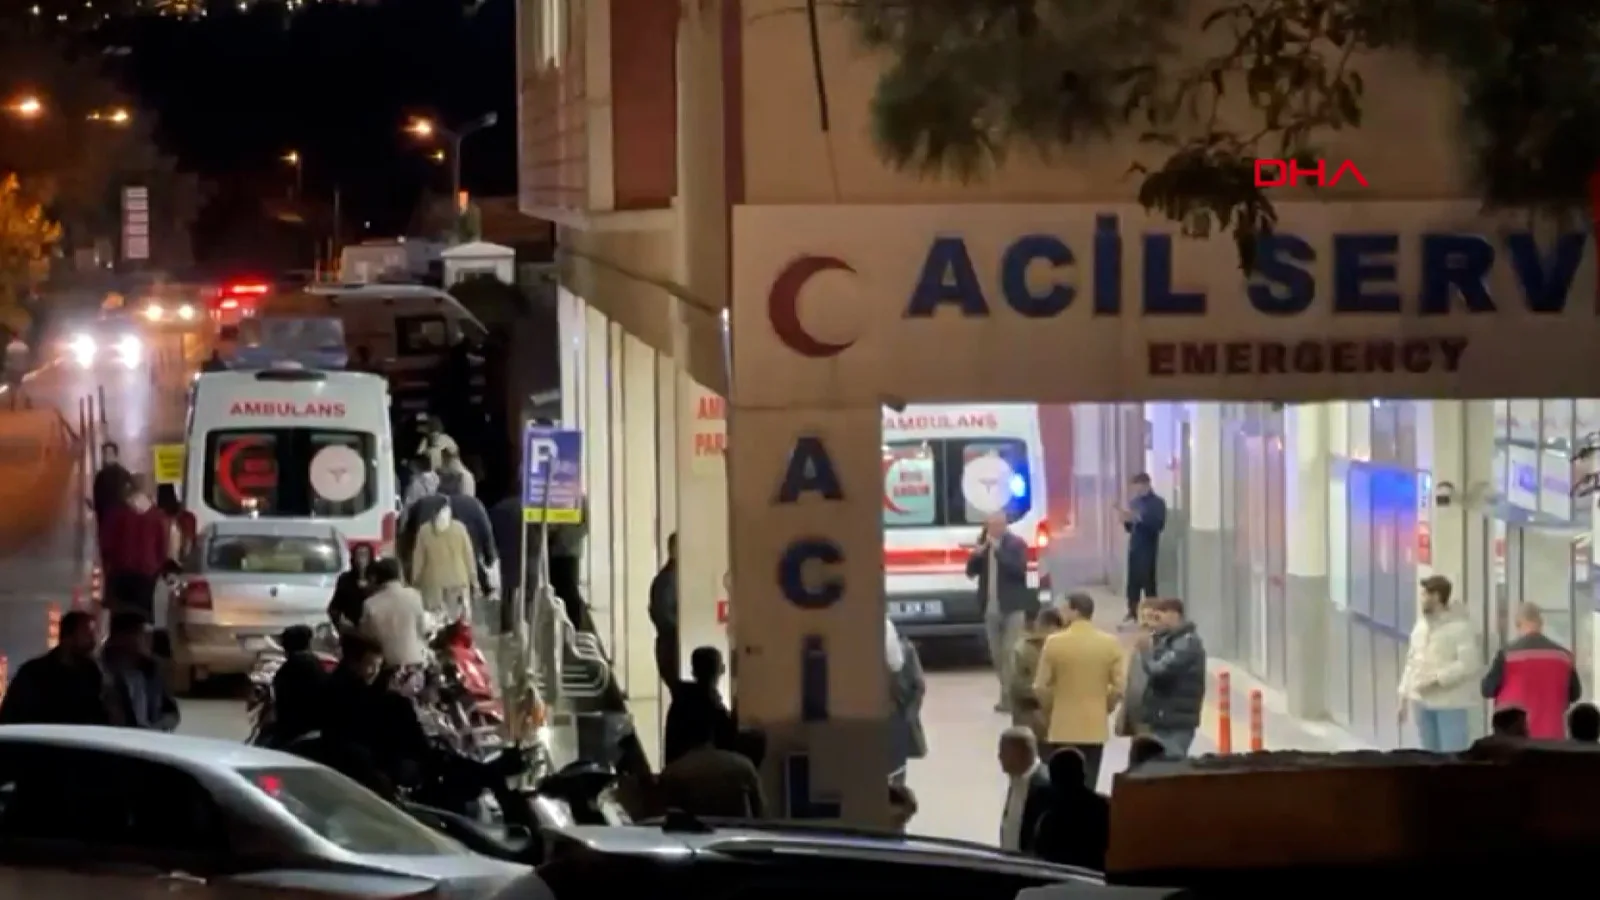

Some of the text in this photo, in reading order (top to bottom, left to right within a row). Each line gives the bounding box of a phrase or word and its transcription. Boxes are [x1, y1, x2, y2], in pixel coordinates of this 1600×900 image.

[905, 213, 1208, 318] ACİL
[1147, 337, 1469, 375] EMERGENCY
[229, 402, 346, 418] AMBULANS
[885, 412, 998, 430] AMBULANS
[531, 438, 558, 474] P
